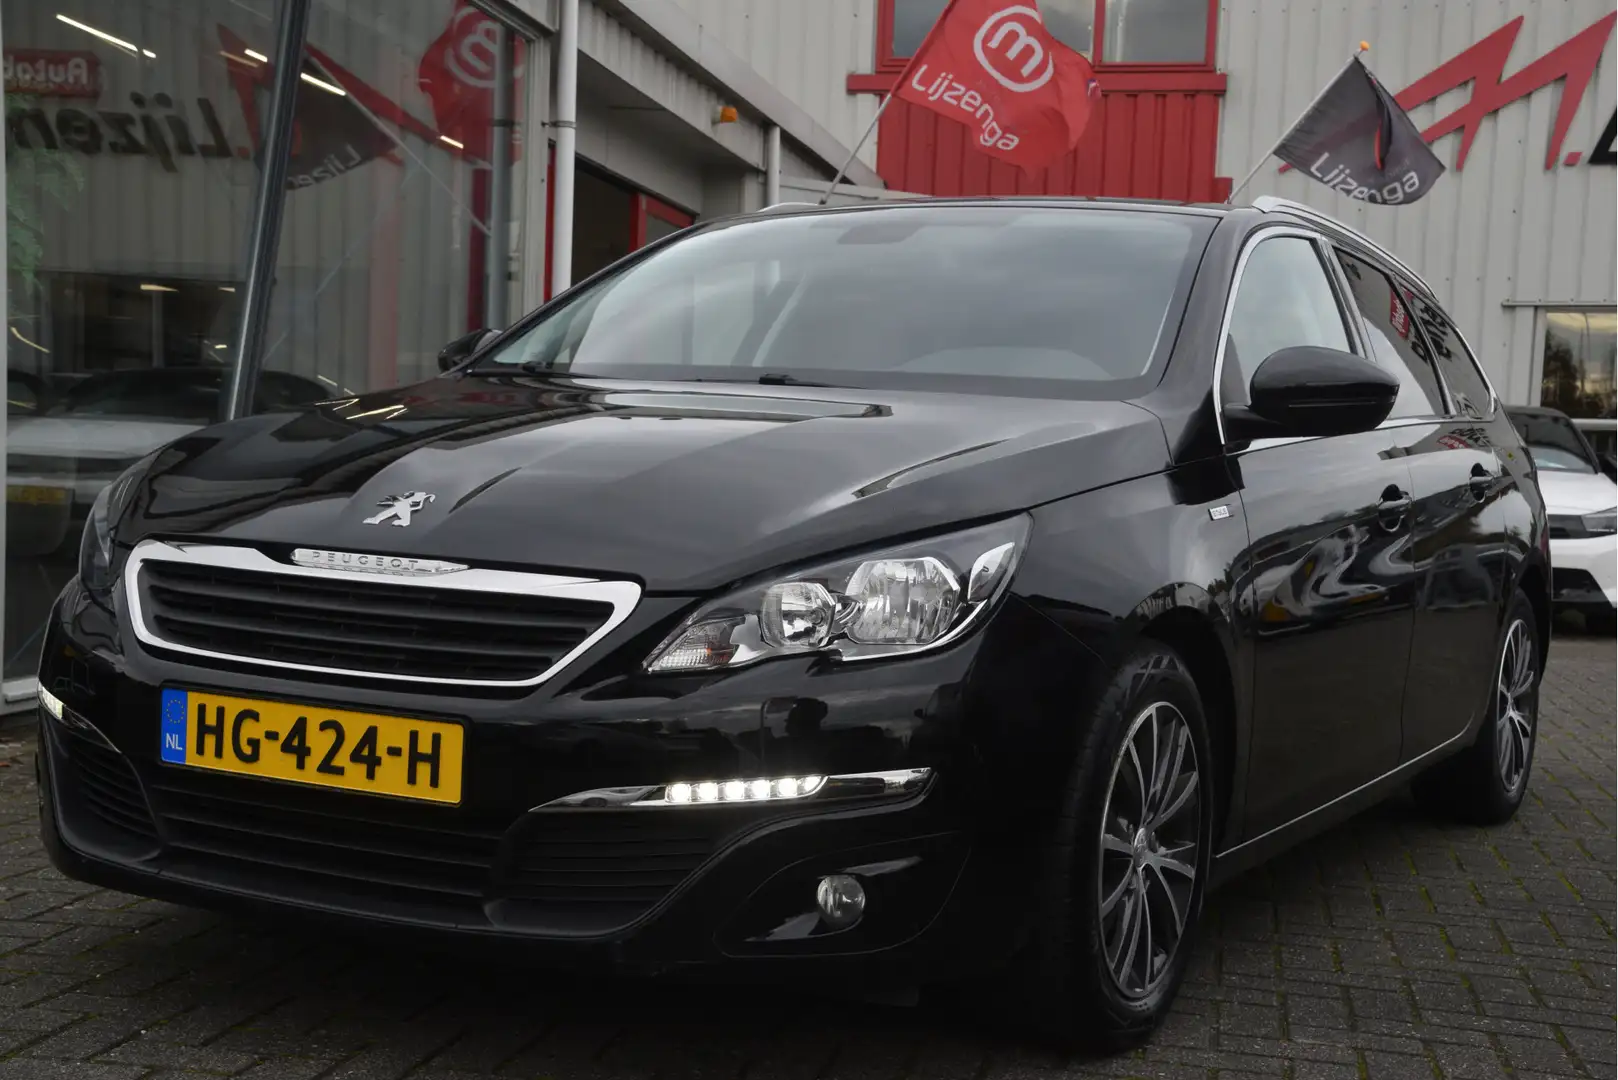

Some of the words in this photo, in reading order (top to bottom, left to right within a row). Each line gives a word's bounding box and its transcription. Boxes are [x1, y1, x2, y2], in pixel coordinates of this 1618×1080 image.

[912, 64, 1019, 150] Lijzenga
[1310, 152, 1419, 204] Lijzenga
[311, 551, 418, 569] PEUGEOT
[165, 733, 183, 751] NL
[195, 702, 442, 789] HG-424-H
